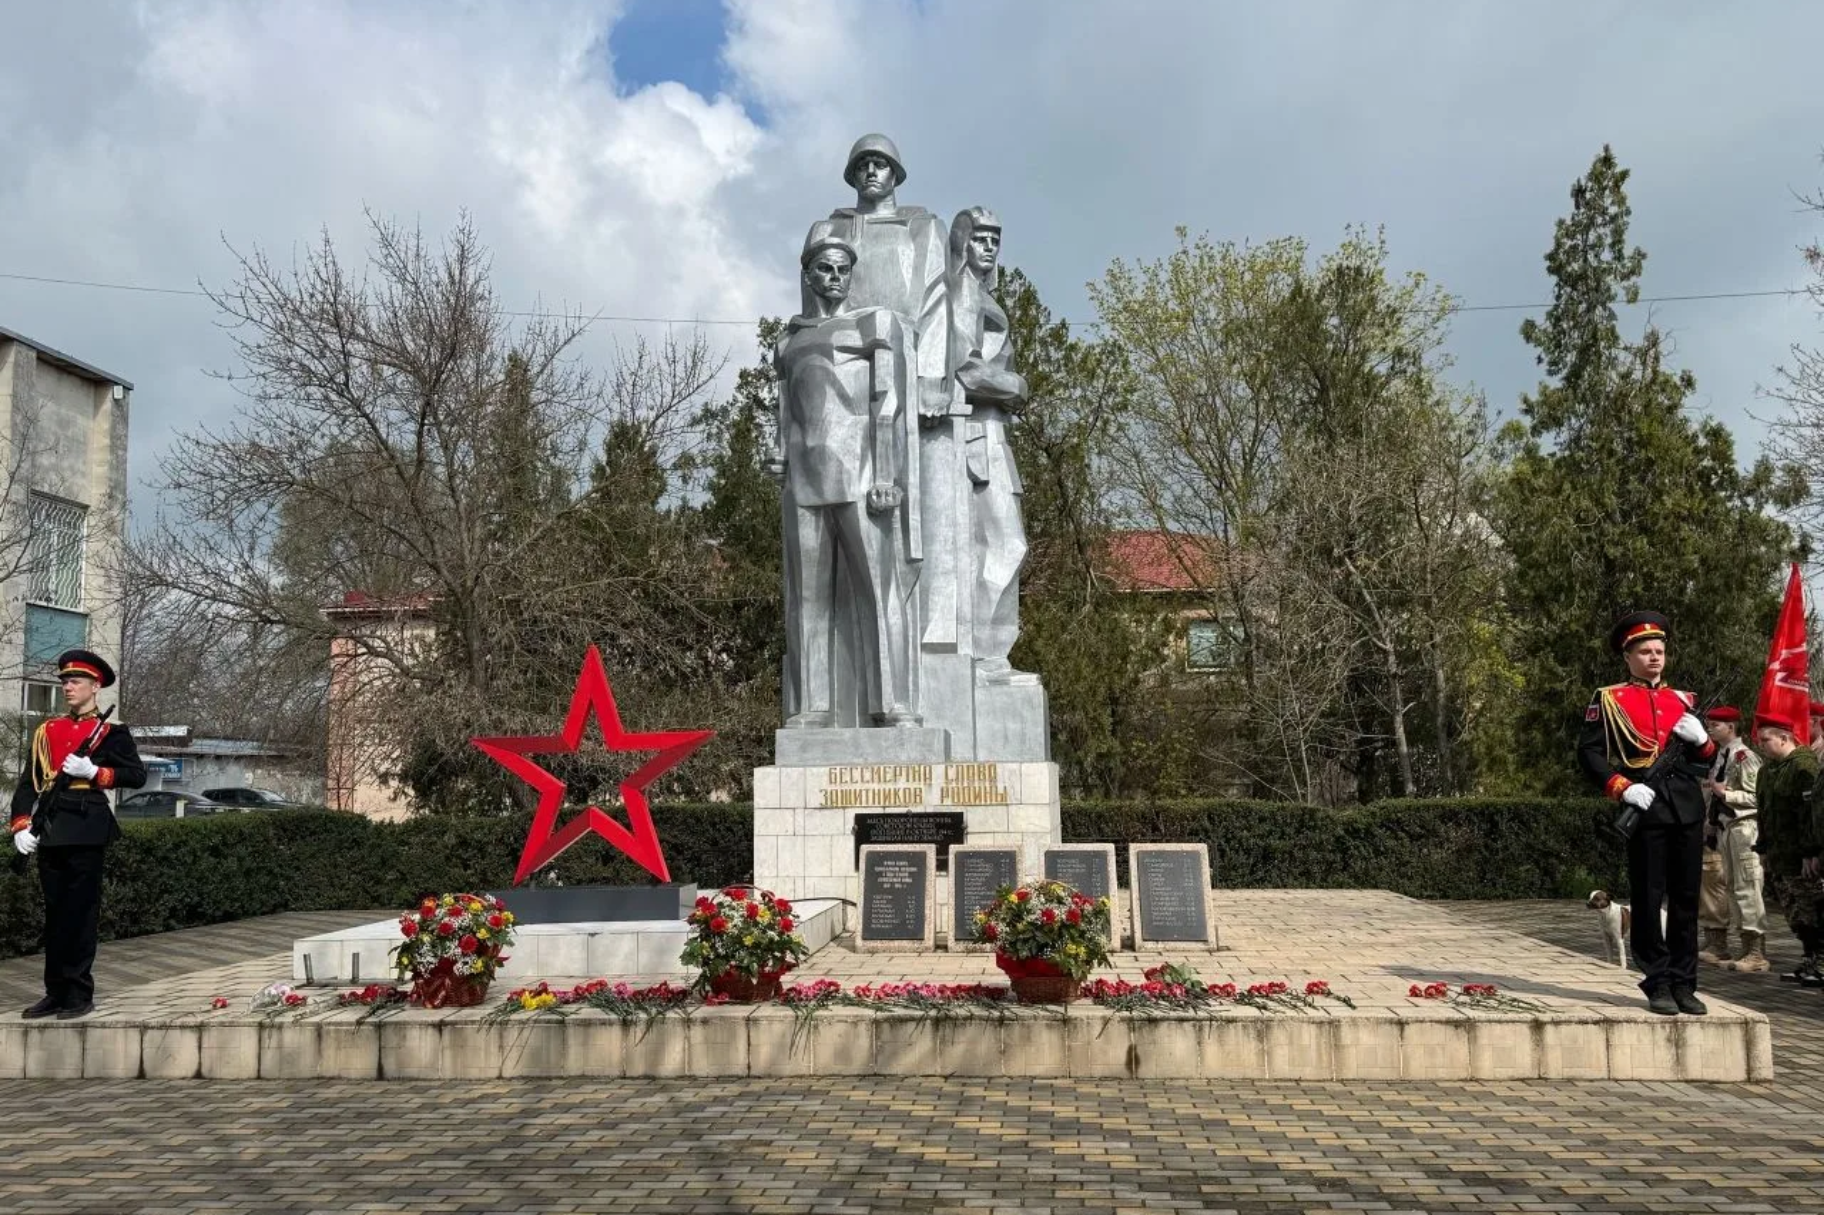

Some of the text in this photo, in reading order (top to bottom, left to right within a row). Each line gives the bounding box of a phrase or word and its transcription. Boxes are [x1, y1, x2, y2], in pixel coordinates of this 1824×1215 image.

[828, 763, 997, 785] БЕССМЕРТНА СЛАВА
[819, 785, 1007, 806] ЗАЩИТНИКОВ РОДИНЫ
